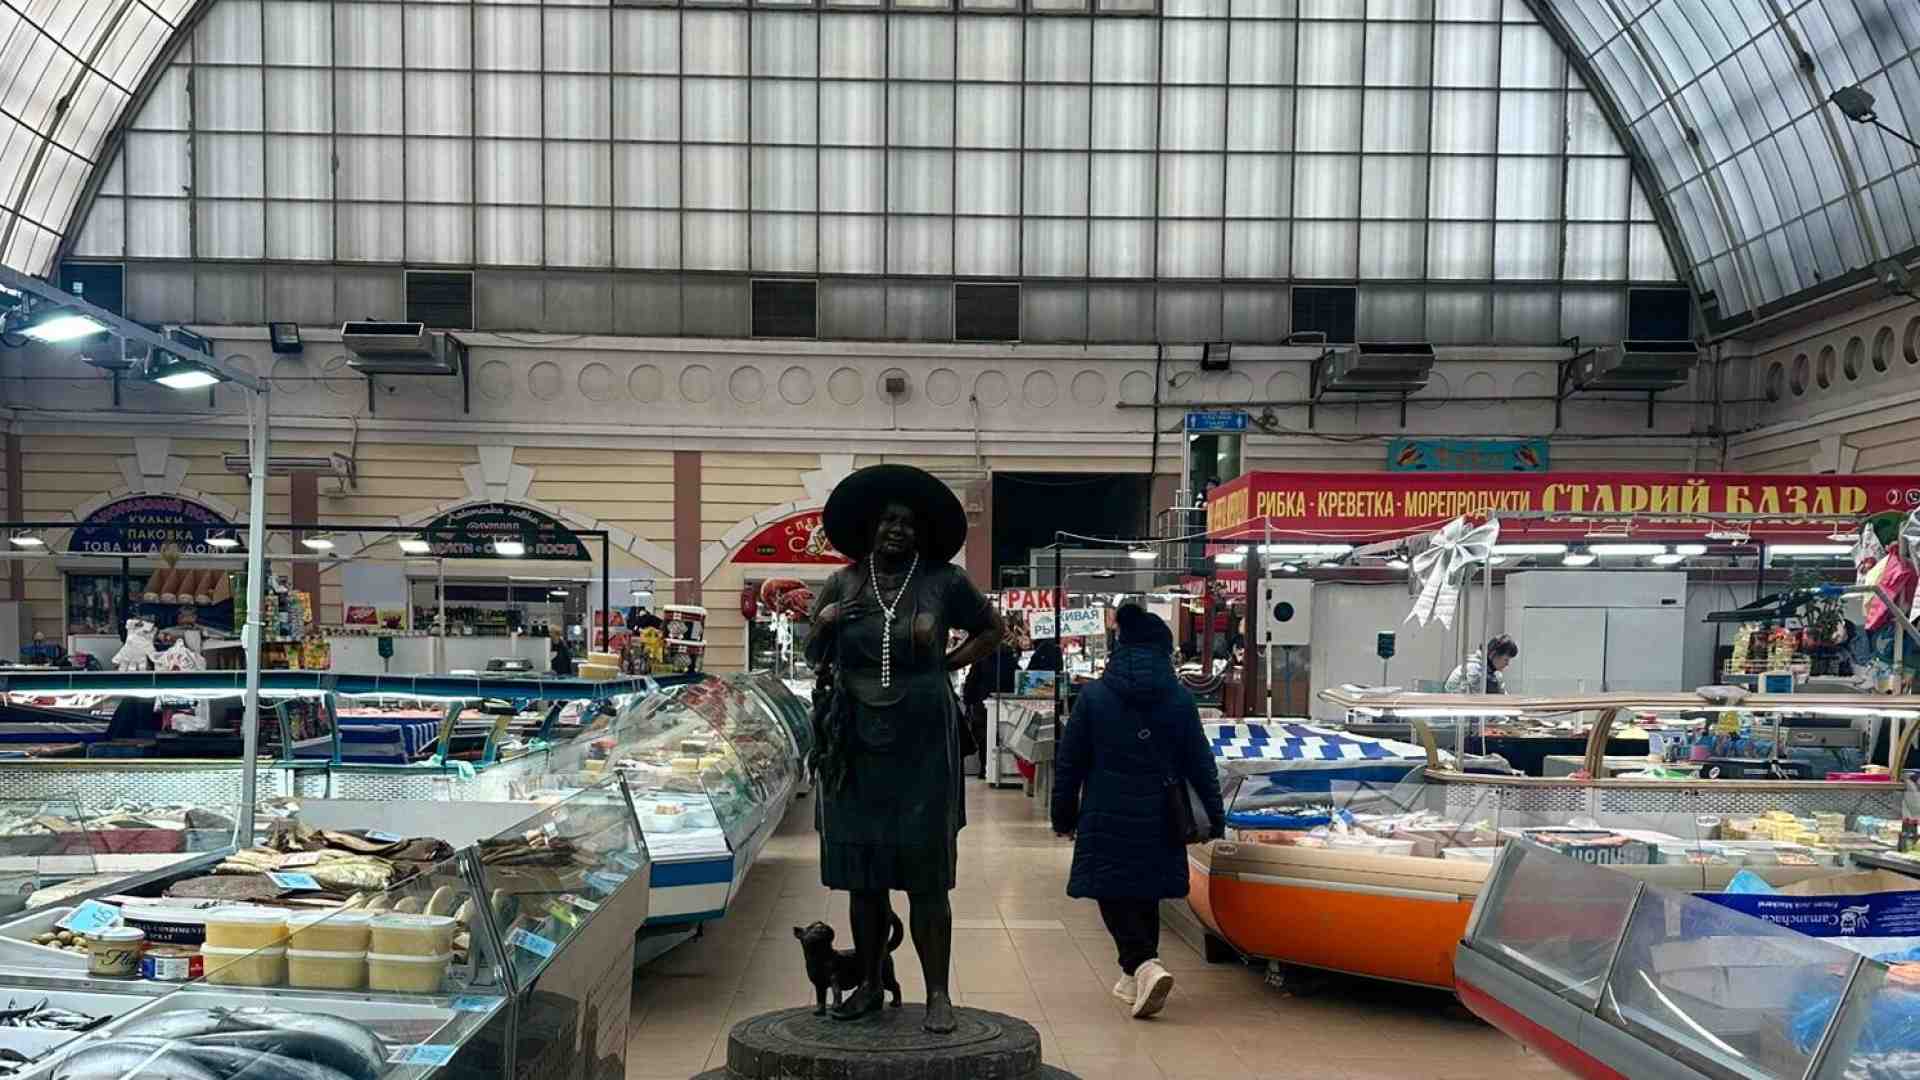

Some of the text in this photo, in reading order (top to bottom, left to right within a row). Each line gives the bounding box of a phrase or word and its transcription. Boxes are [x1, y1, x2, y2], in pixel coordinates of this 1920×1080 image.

[1257, 491, 1306, 518] РИБКА
[1317, 490, 1394, 518] КРЕВЕТКА
[1404, 490, 1531, 519] МОРЕПРОДУКТИ
[1541, 478, 1868, 525] СТАРИЙ БАЗАР
[119, 529, 194, 540] ПАКОКА
[81, 541, 142, 552] ТОВАИ
[1034, 623, 1072, 635] РЫА
